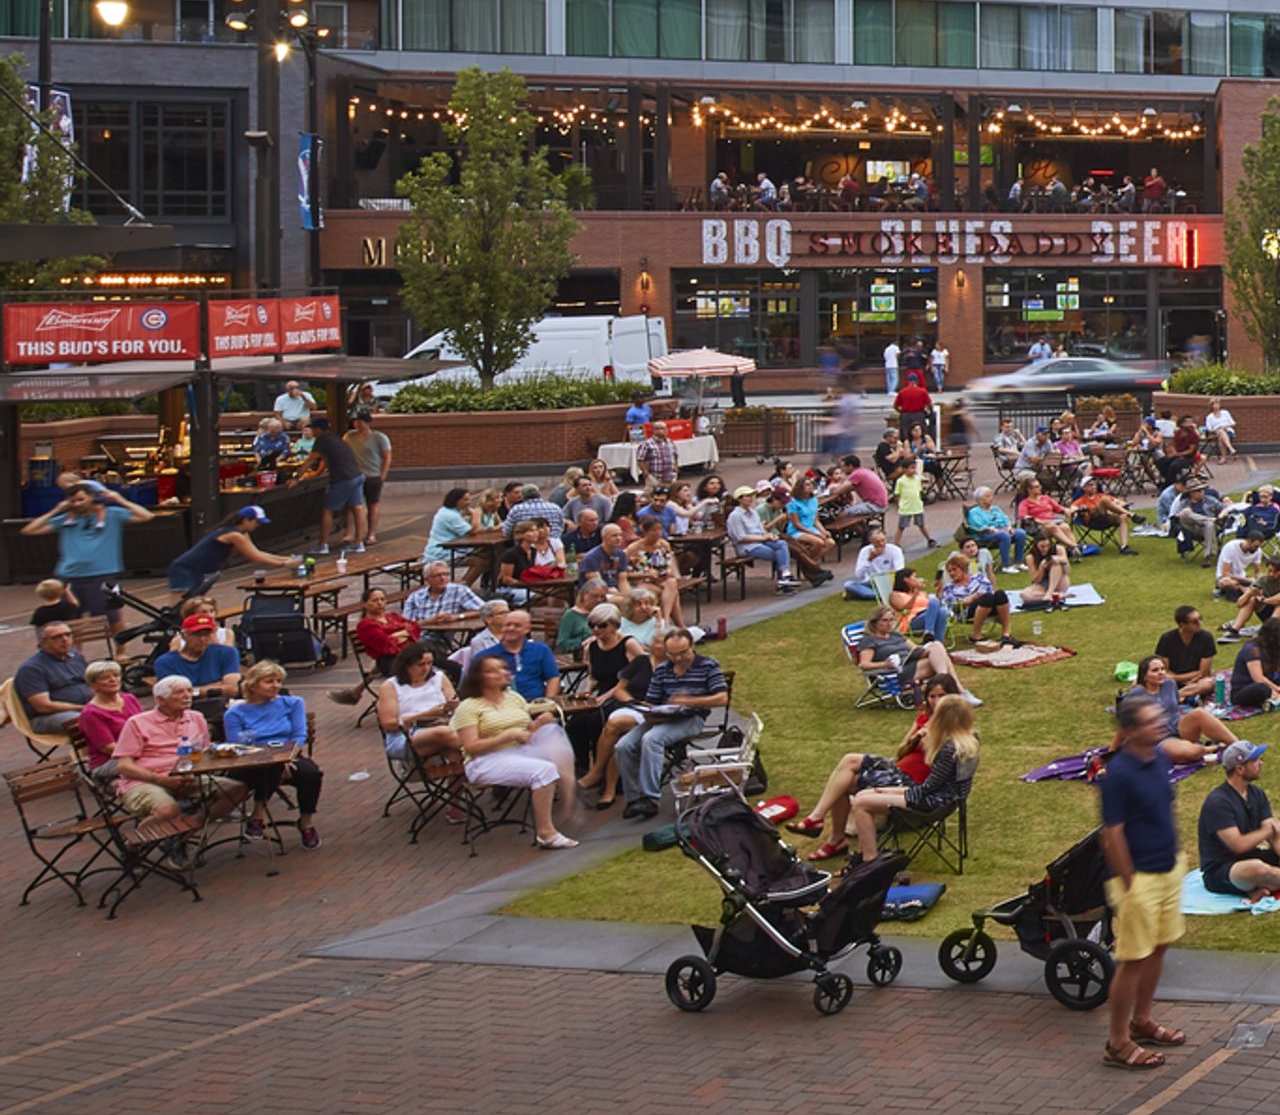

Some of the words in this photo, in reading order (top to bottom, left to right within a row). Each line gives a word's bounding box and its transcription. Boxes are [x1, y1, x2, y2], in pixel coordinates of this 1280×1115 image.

[702, 218, 792, 268] BBQ
[880, 219, 1013, 264] BLUES
[1091, 220, 1188, 264] BEER
[44, 312, 111, 326] Budweiser
[17, 341, 55, 356] THIS
[59, 339, 109, 355] BUD'S
[112, 340, 144, 354] FOR
[148, 339, 187, 354] YOU.
